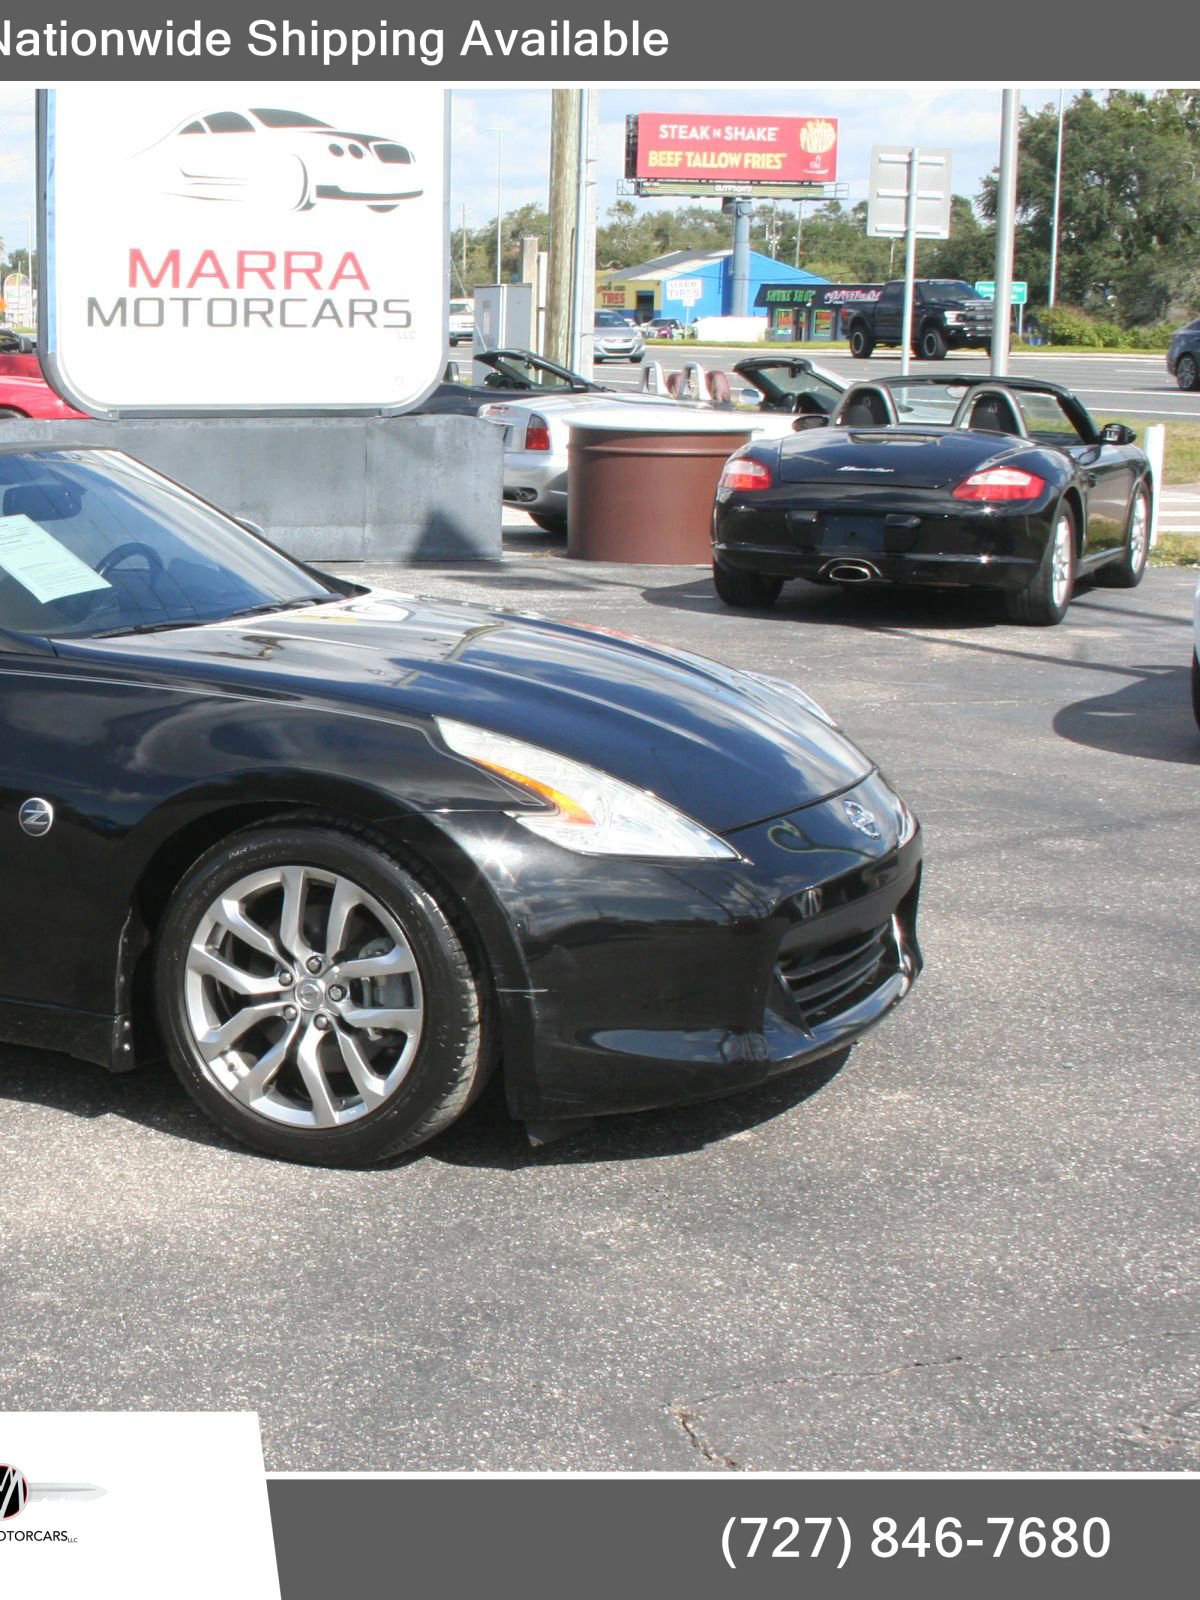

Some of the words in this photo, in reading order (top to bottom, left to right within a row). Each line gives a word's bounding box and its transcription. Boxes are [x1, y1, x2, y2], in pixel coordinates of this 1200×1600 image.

[659, 124, 709, 140] STEAK
[724, 126, 778, 142] SHAKE
[648, 151, 683, 167] BEEF
[686, 152, 742, 168] TALLOW
[128, 248, 370, 290] MARRA
[602, 292, 626, 304] TIRES
[87, 297, 412, 328] MOTORCARS
